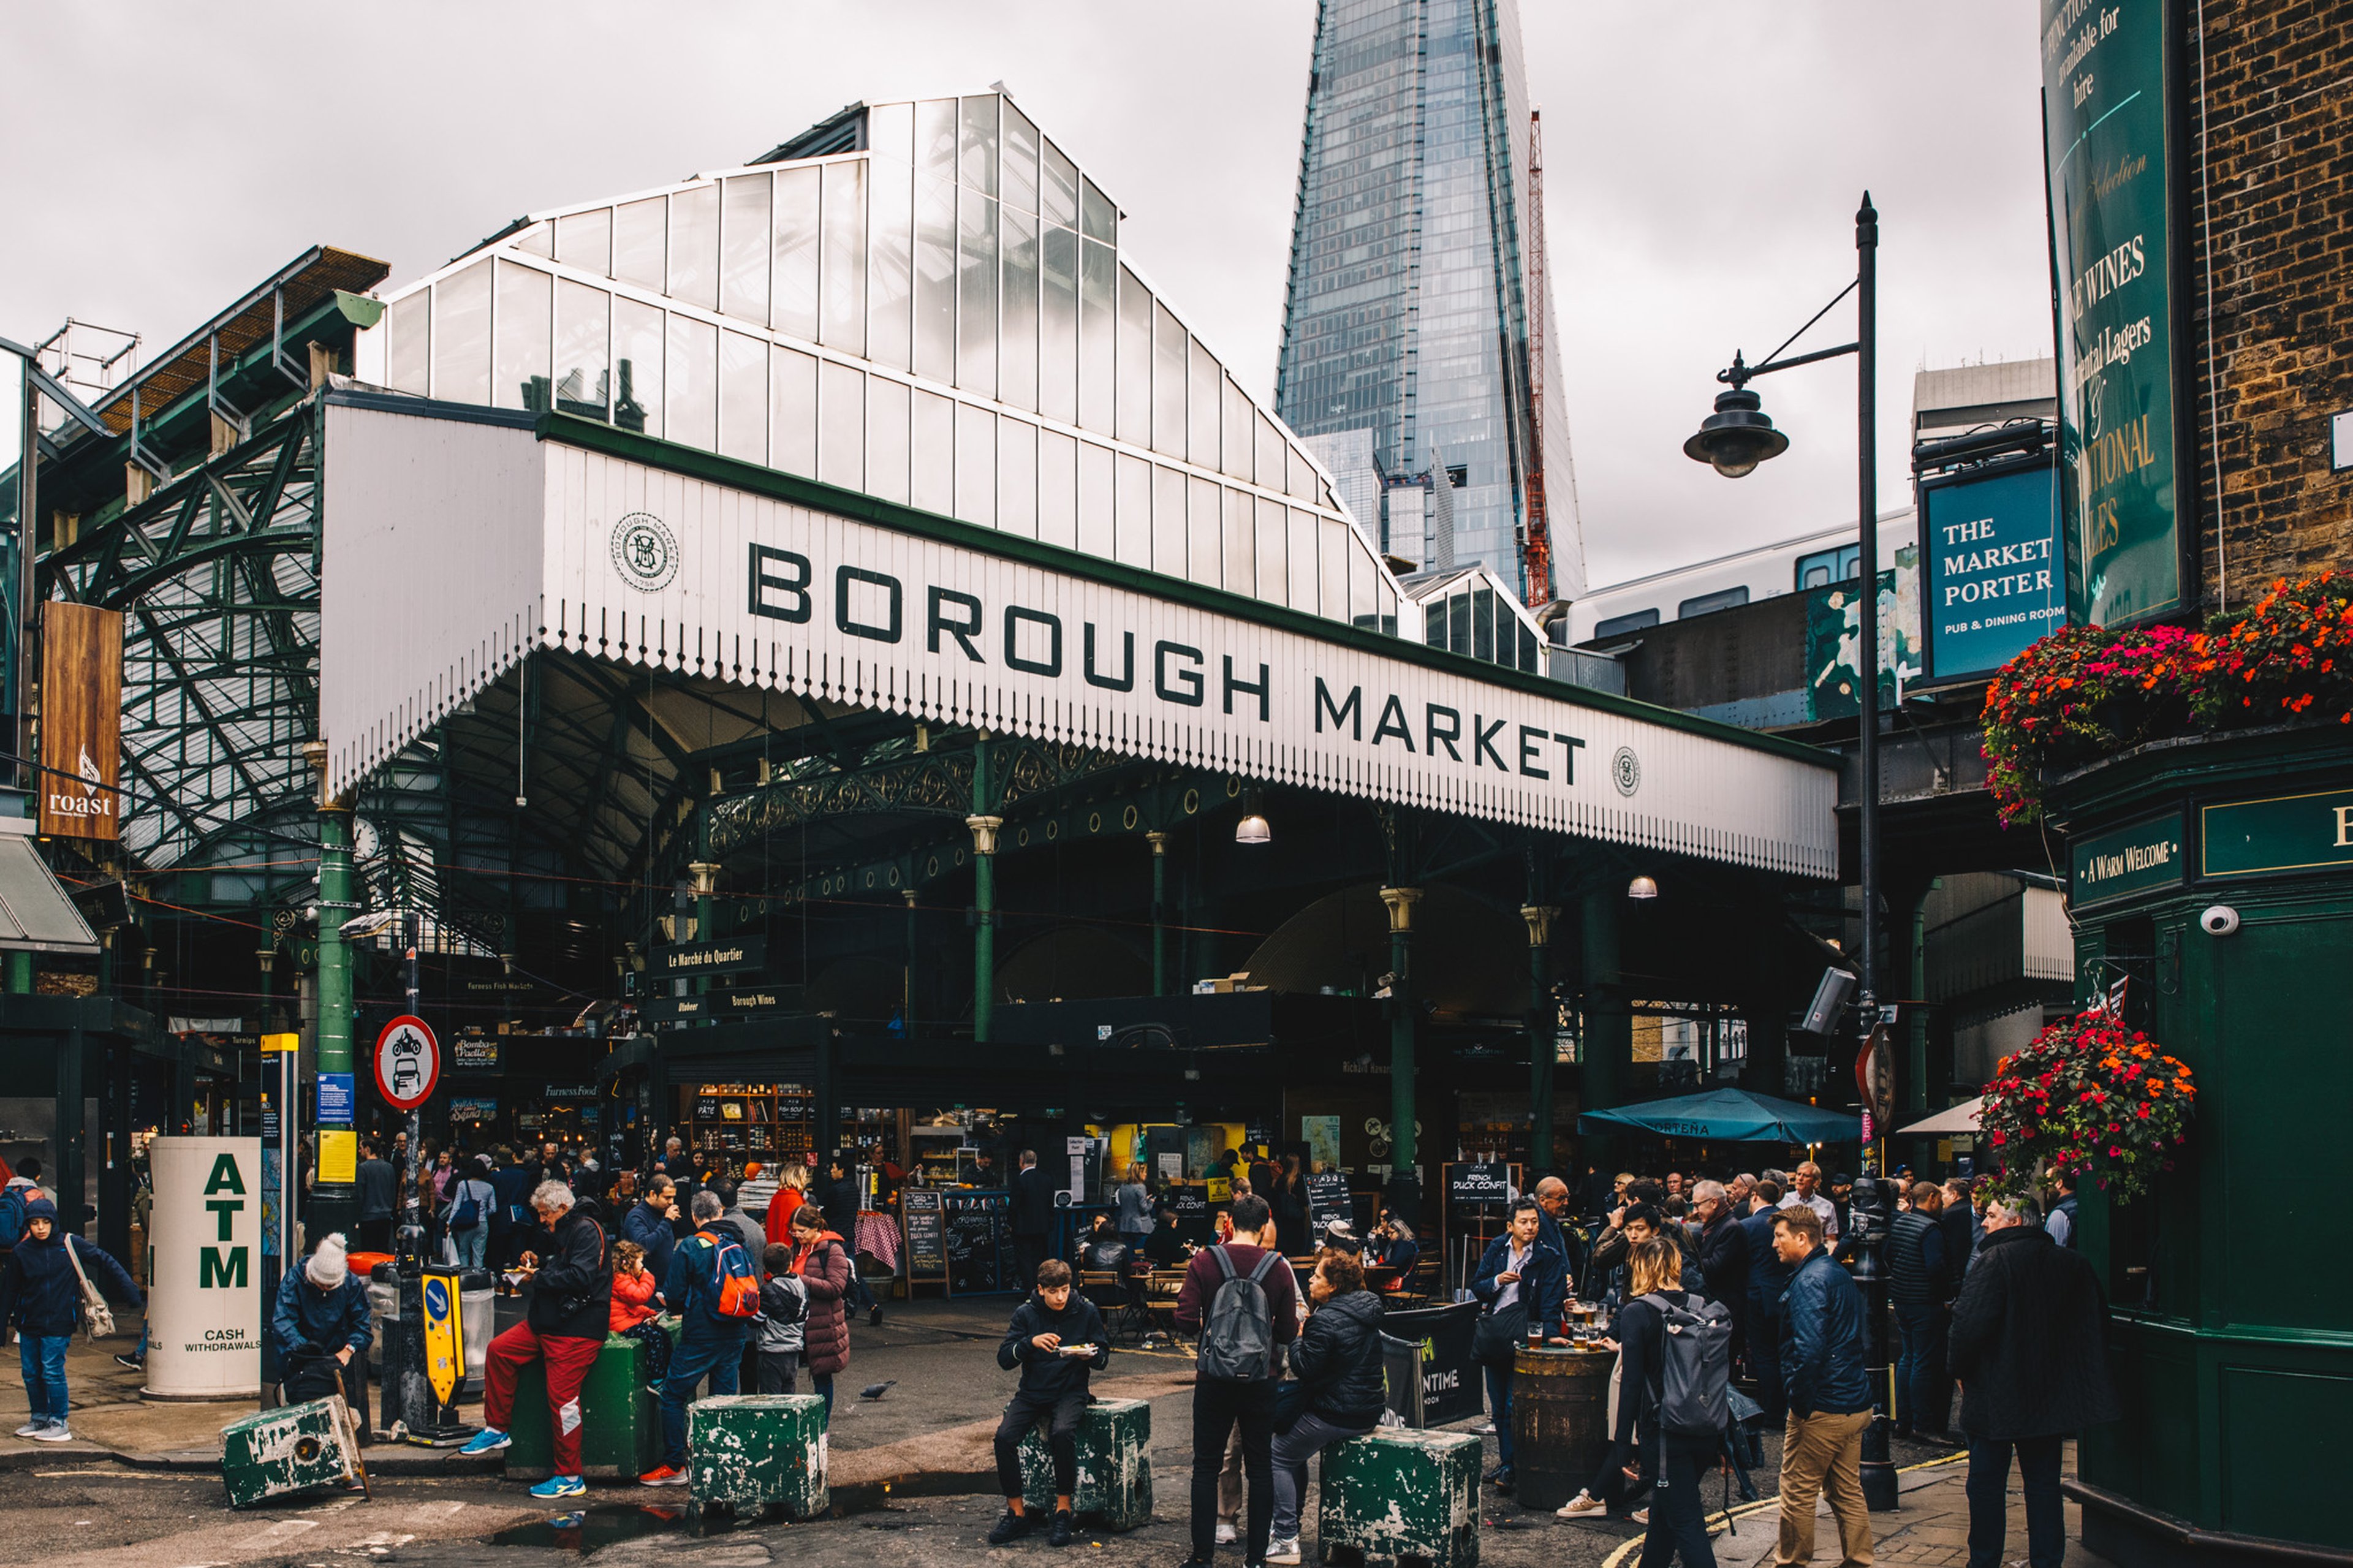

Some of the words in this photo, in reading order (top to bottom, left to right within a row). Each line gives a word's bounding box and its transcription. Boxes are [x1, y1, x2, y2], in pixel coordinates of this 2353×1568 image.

[2059, 23, 2097, 87] available
[2100, 7, 2120, 40] for
[2073, 73, 2094, 109] hire
[2085, 234, 2145, 308] WINES
[2105, 316, 2151, 365] Lagers
[615, 517, 648, 559] BOROUGH
[653, 523, 675, 570] MARKET
[1942, 518, 1995, 545] THE
[1944, 537, 2052, 575] MARKET
[1945, 569, 2053, 606] PORTER
[1945, 623, 1968, 635] PUB
[1971, 619, 1982, 630] &
[1985, 612, 2026, 629] DINING
[2029, 605, 2065, 622] ROOM
[749, 542, 1268, 723] BOROUGH
[1316, 676, 1585, 786] MARKET
[50, 793, 111, 816] roast
[2088, 860, 2096, 884] A
[2097, 852, 2124, 881] WARM
[2126, 840, 2169, 873] WELCOME
[669, 954, 677, 968] Le
[678, 952, 702, 967] Marché
[703, 950, 713, 964] du
[713, 947, 743, 964] Quartier
[731, 994, 757, 1008] Borough
[757, 993, 776, 1006] Wines
[232, 1036, 256, 1045] Turnips
[459, 1047, 486, 1058] Paella
[460, 1039, 490, 1048] Bomba
[545, 1085, 577, 1097] Furness
[577, 1085, 597, 1096] Food
[1477, 1181, 1507, 1189] CONFIT
[200, 1153, 248, 1289] ATM
[1313, 1221, 1330, 1229] DUCK
[185, 1340, 262, 1352] WITHDRAWALS
[205, 1329, 244, 1341] CASH
[1423, 1369, 1460, 1393] NTIME
[1424, 1395, 1439, 1405] NDON
